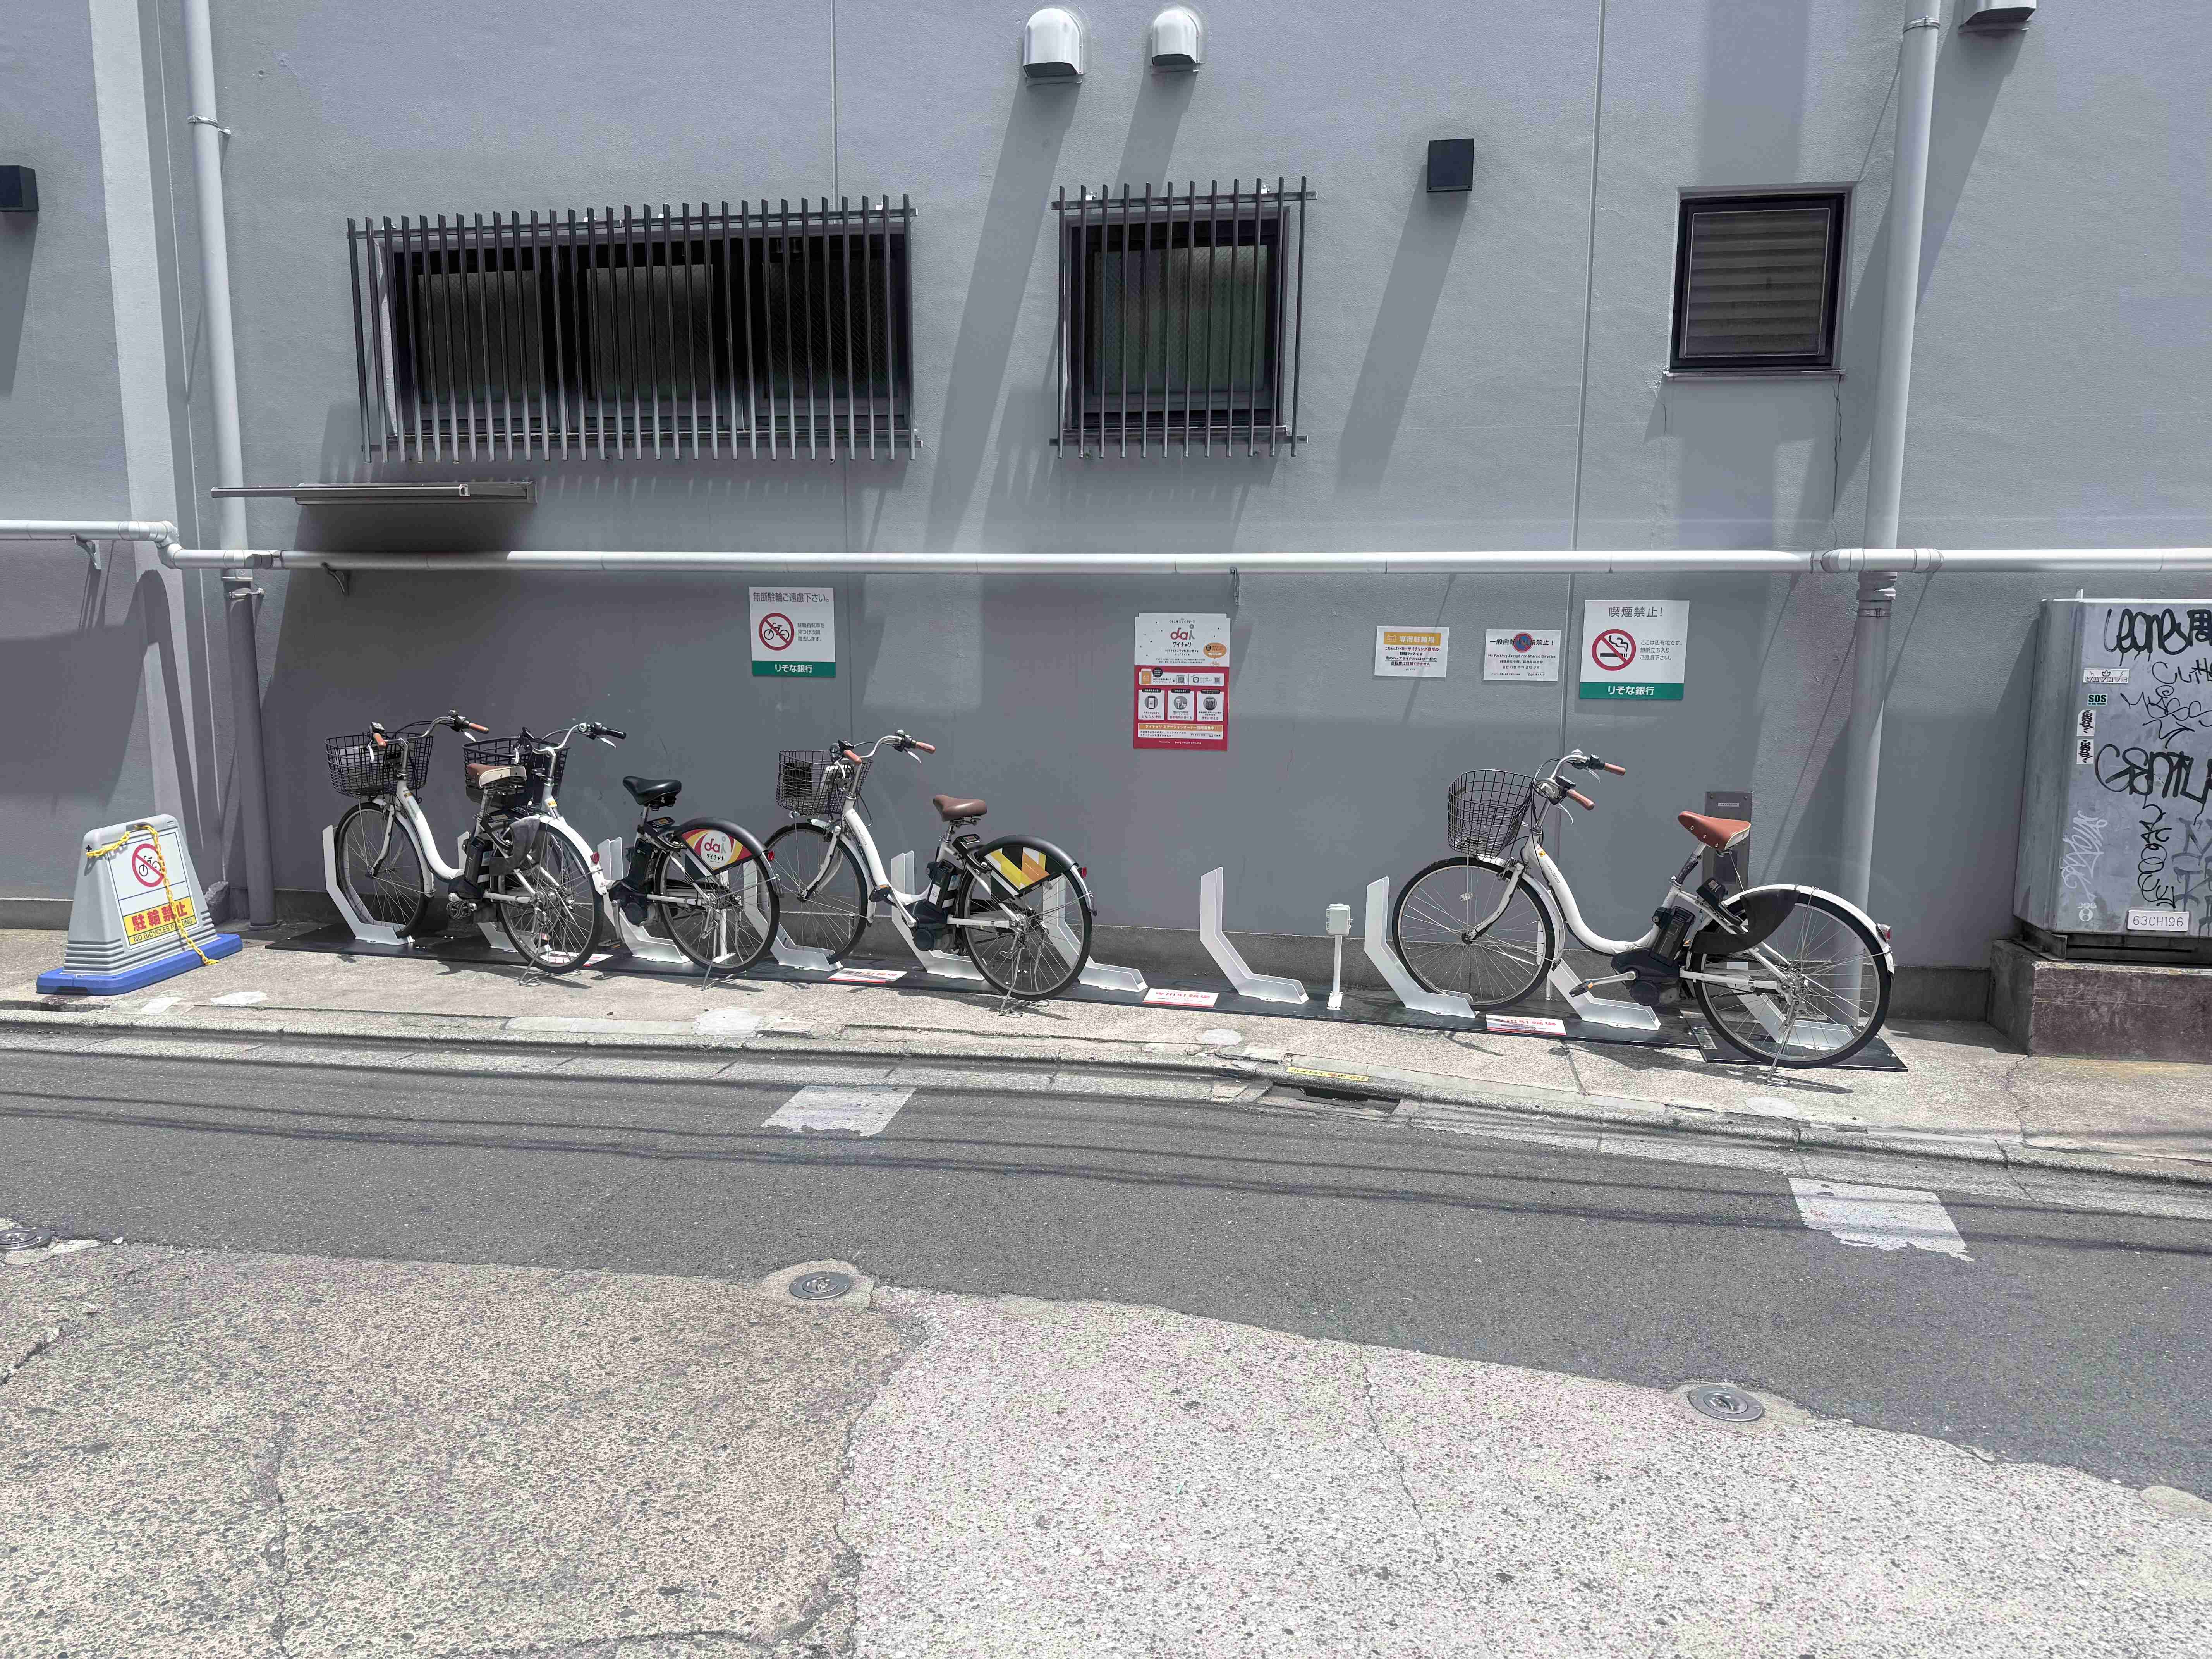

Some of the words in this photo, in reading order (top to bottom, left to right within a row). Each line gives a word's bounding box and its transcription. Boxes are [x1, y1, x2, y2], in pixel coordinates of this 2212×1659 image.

[753, 592, 830, 603] 無断駐輪ご遠慮下さい。
[1170, 624, 1195, 640] dai
[775, 664, 813, 673] りそな銀行
[1608, 685, 1655, 695] りそな銀行
[704, 836, 726, 853] dai
[131, 901, 188, 931] 駐輪禁止
[2133, 915, 2183, 927] 63CH196
[144, 926, 170, 939] BICYCLES
[170, 918, 192, 930] PAING
